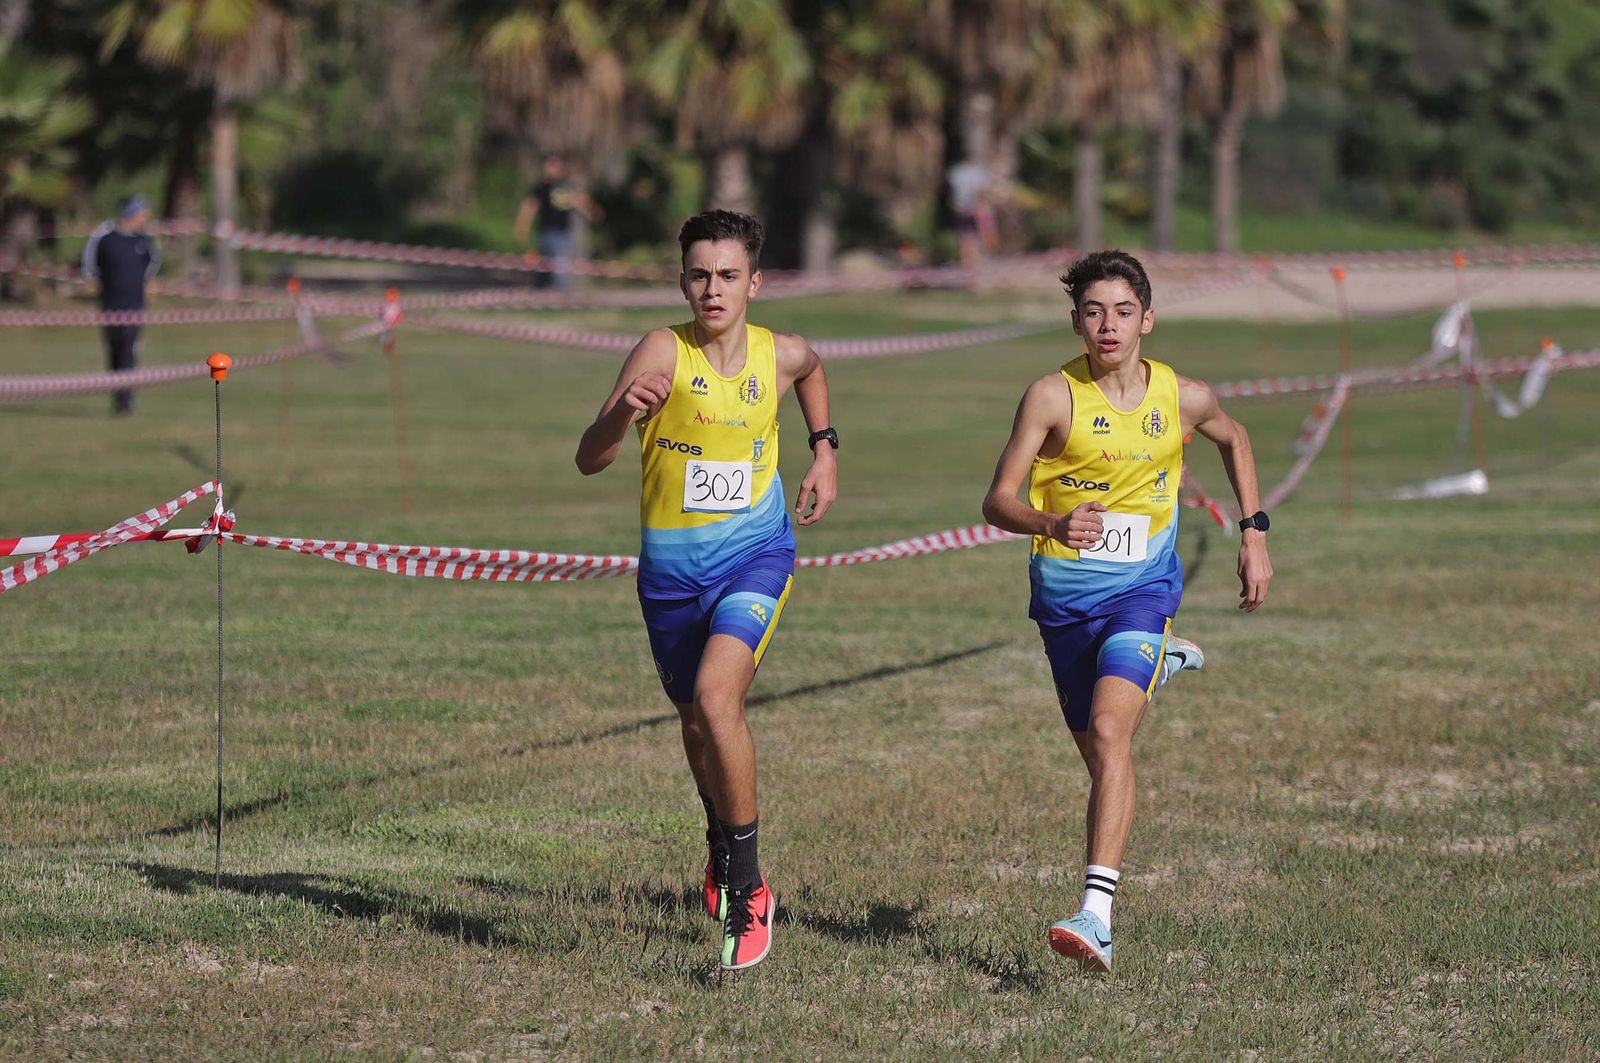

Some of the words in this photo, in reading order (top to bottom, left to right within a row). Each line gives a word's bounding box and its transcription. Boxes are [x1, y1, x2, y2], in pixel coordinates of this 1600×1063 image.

[1093, 428, 1111, 436] mobel
[656, 437, 703, 456] EVOS
[691, 469, 745, 502] 302
[1059, 475, 1110, 491] EVOS
